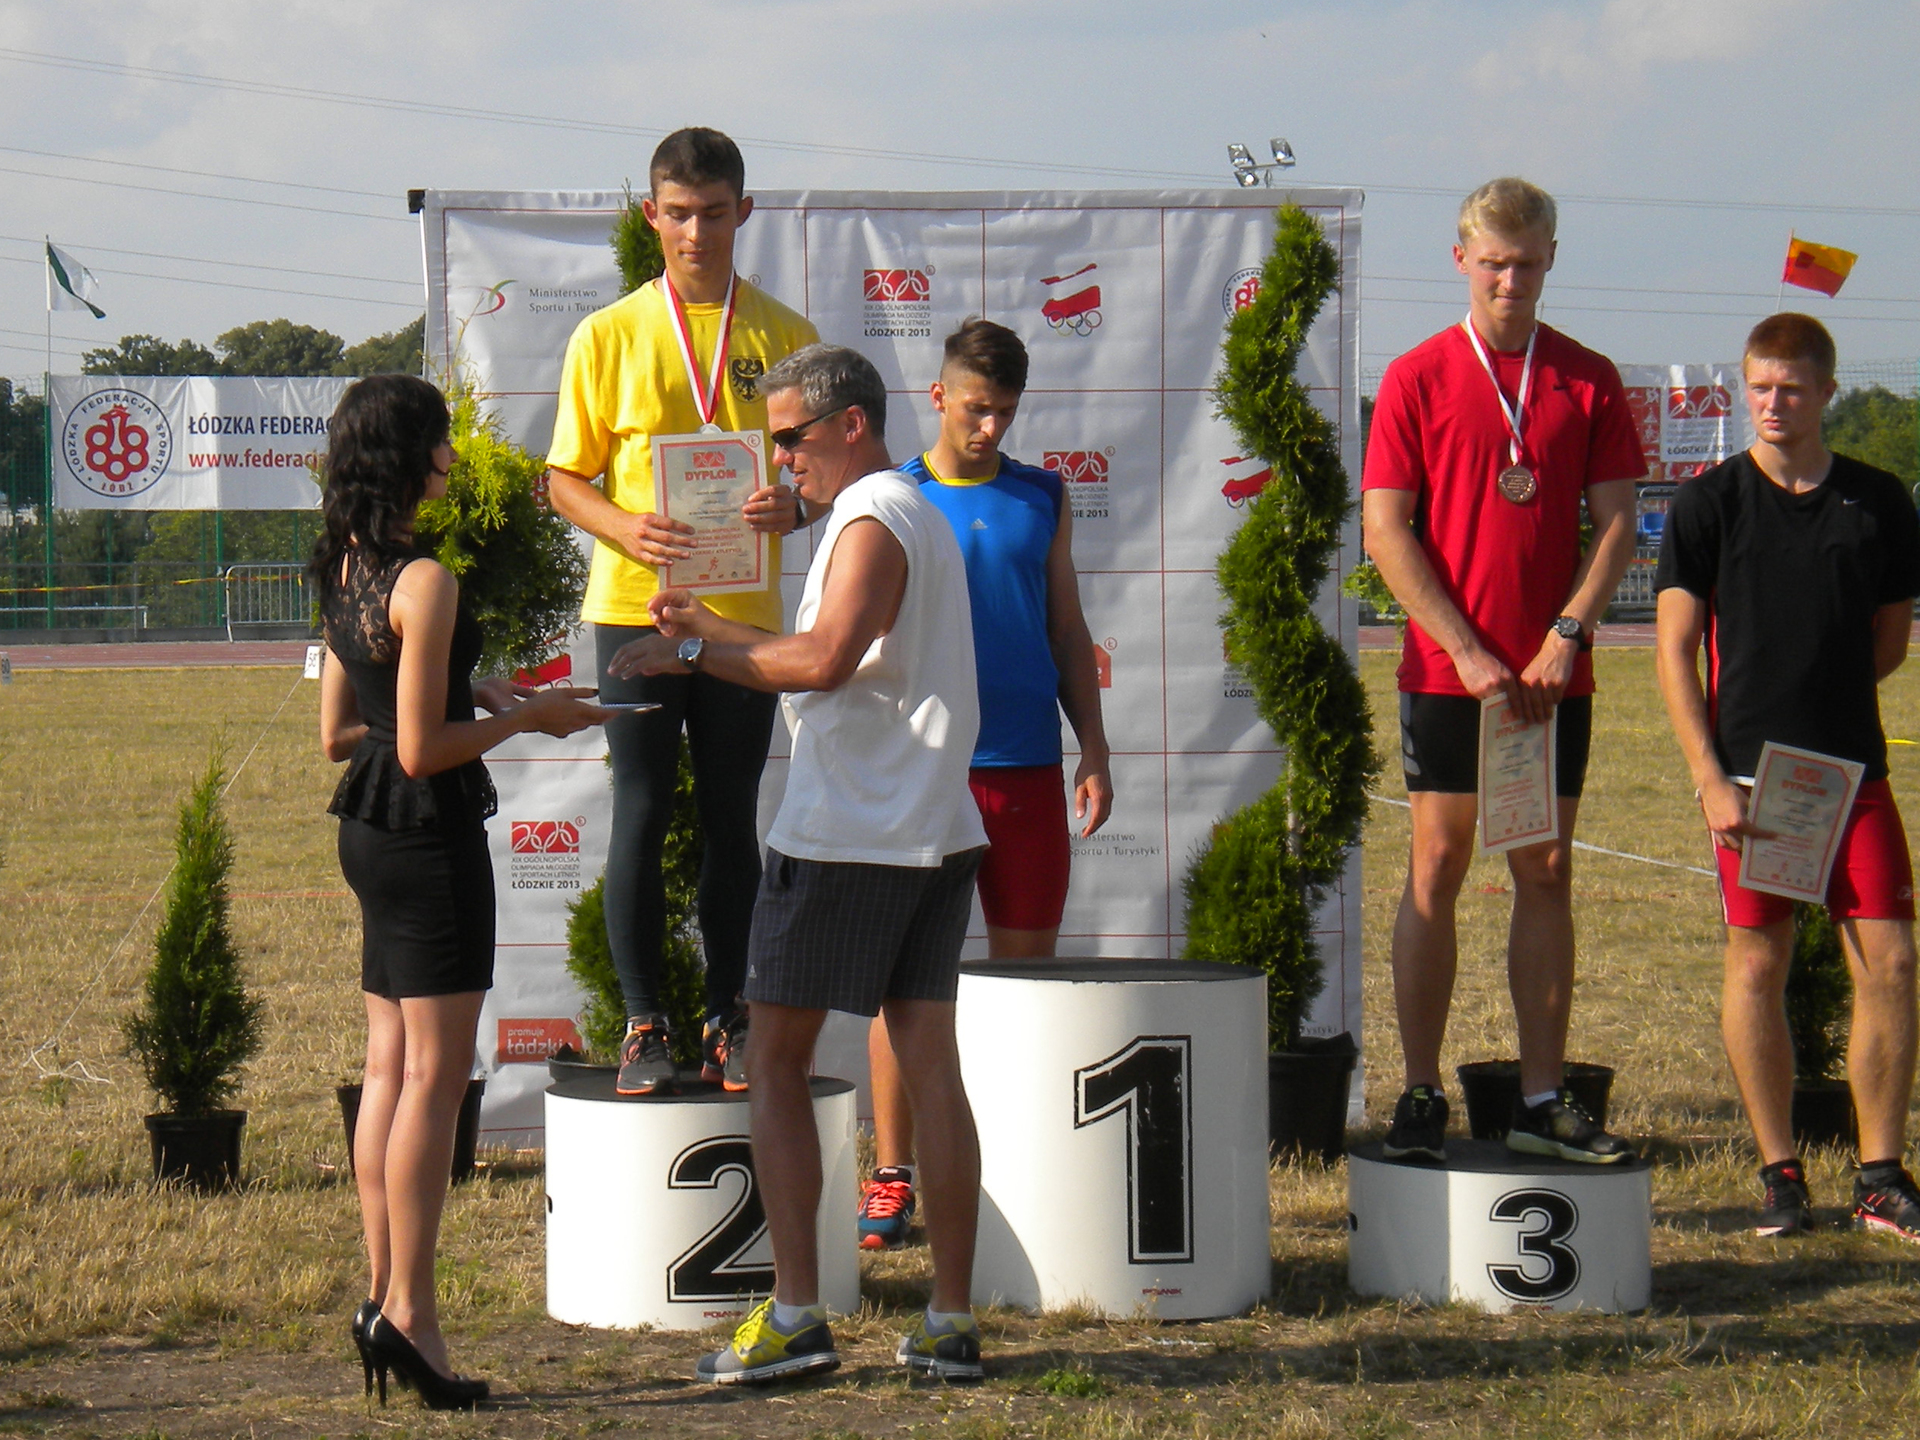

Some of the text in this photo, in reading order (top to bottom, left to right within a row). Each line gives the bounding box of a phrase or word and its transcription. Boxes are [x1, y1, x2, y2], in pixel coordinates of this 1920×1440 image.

[529, 288, 598, 297] Ministerstwo
[529, 303, 564, 313] Sportu
[864, 327, 931, 337] ŁÓDZKIE 2013
[81, 394, 152, 415] FEDERACJA
[188, 412, 256, 435] ŁÓDZKA
[151, 423, 167, 474] SPORTU
[685, 469, 737, 481] DYPLOM
[1087, 509, 1109, 518] 2013
[1113, 847, 1160, 857] Turystyki
[523, 855, 580, 863] OGÓLNOPOLSKA
[511, 879, 580, 889] ŁÓDZKIE 2013
[507, 1028, 545, 1038] promuje
[1074, 1034, 1194, 1265] 1
[667, 1134, 777, 1303] 2
[1486, 1187, 1581, 1303] 3
